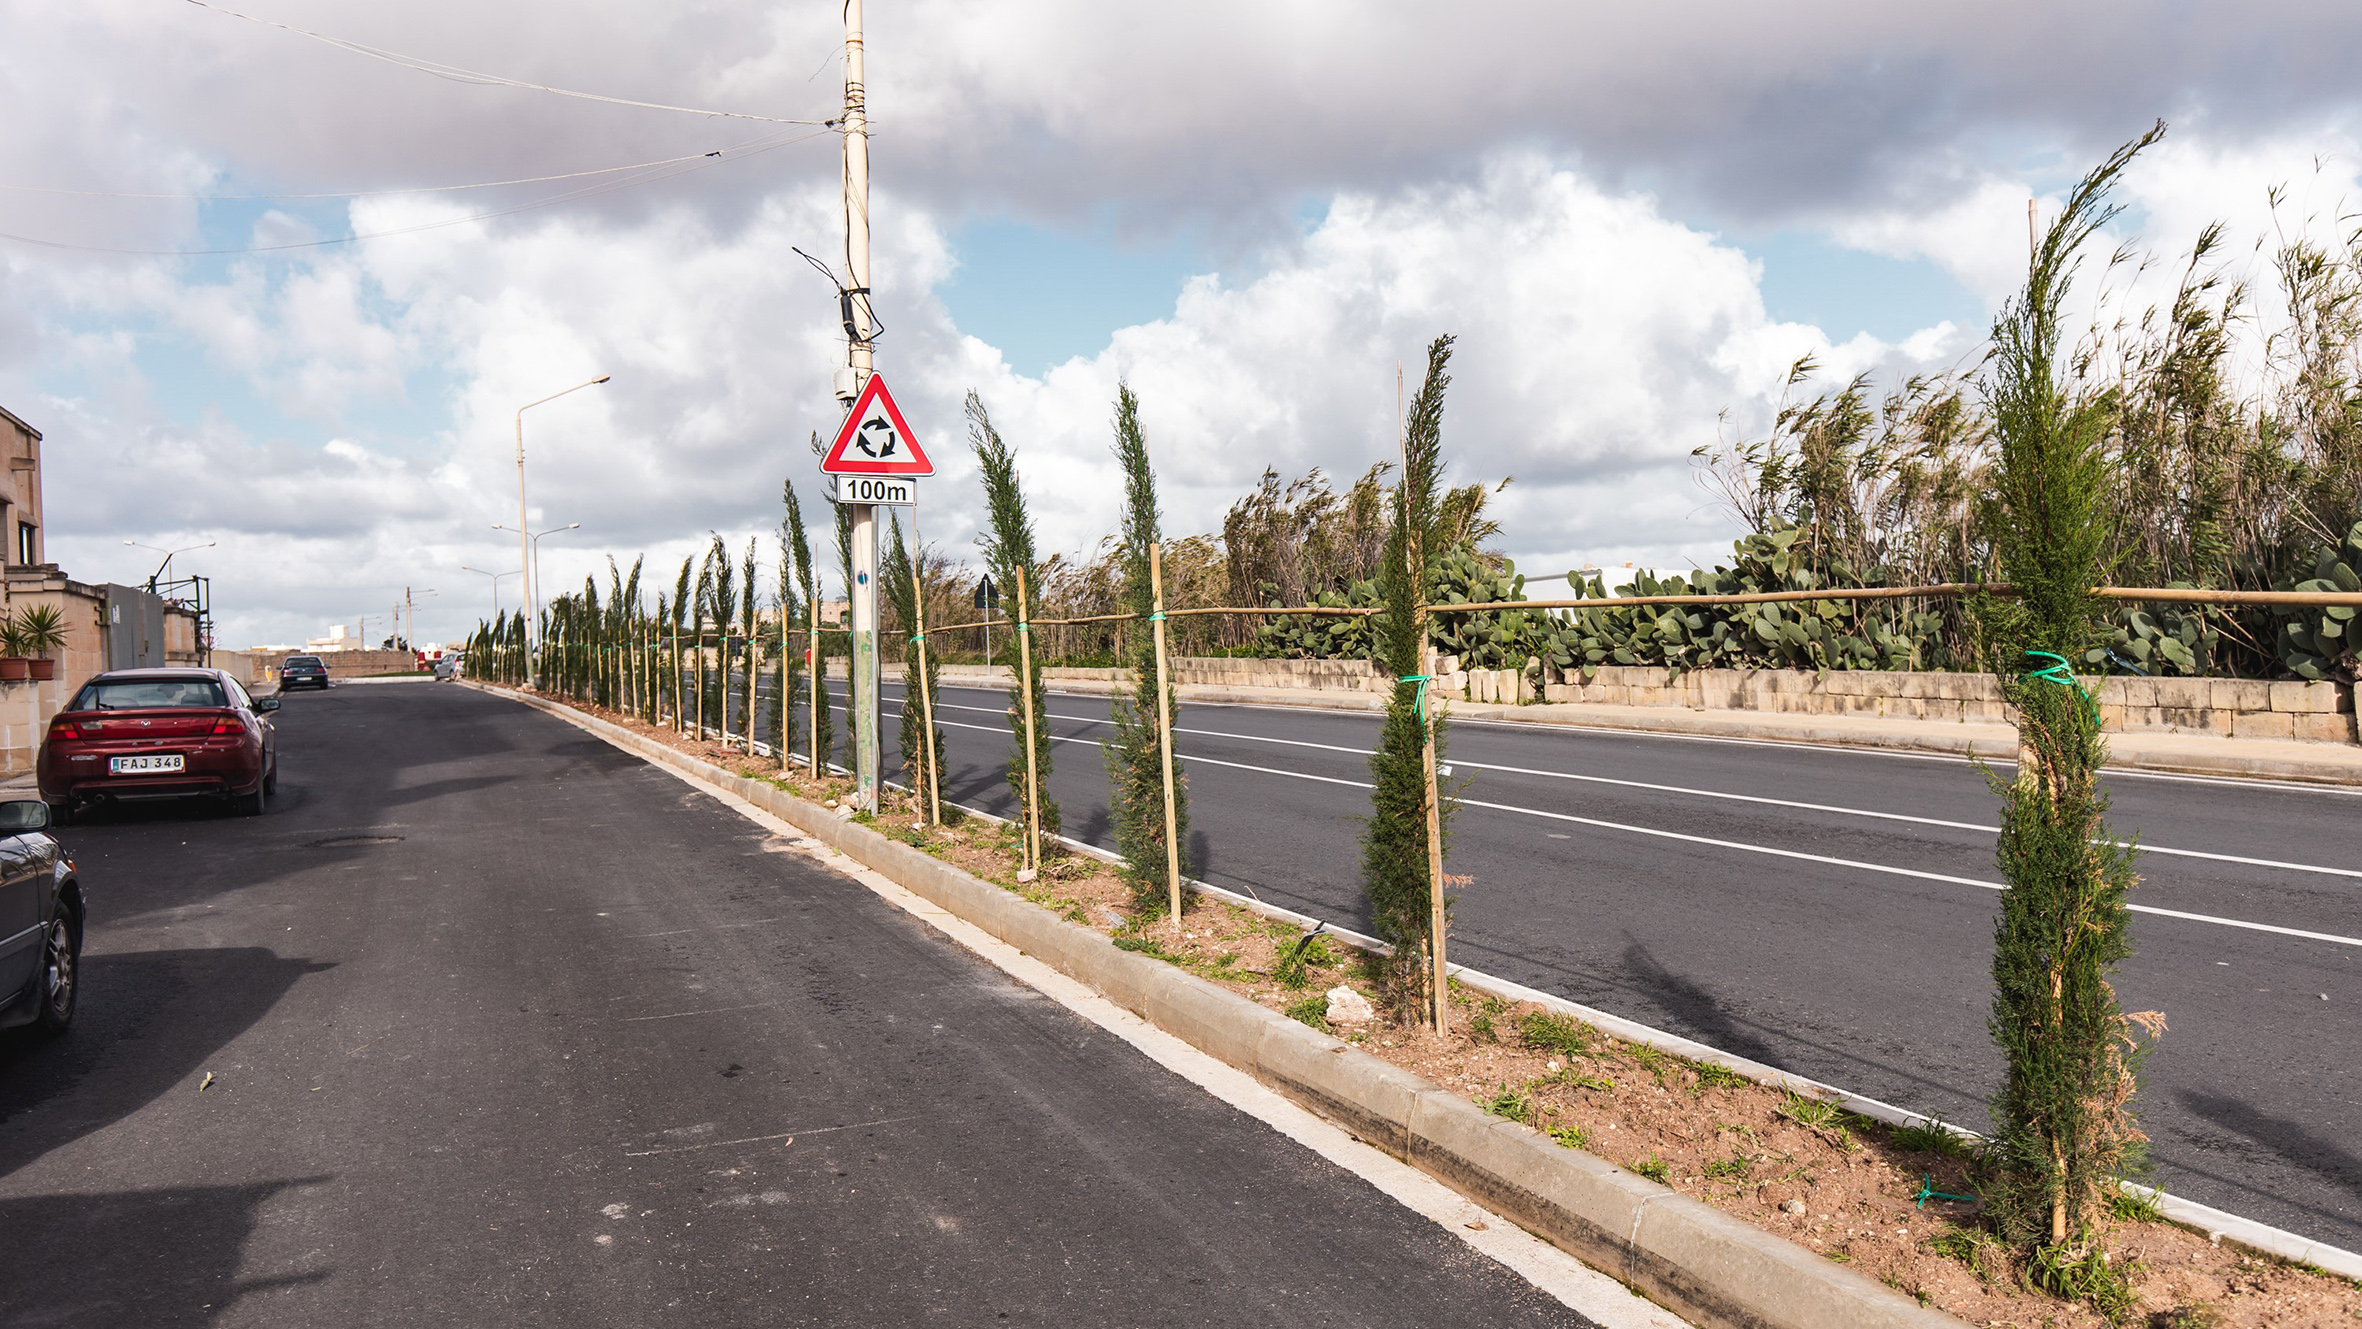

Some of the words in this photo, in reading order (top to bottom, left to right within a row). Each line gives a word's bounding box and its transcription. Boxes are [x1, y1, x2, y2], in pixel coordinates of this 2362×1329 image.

[848, 479, 906, 501] 100m
[120, 758, 148, 770] FAJ
[154, 757, 181, 768] 348
